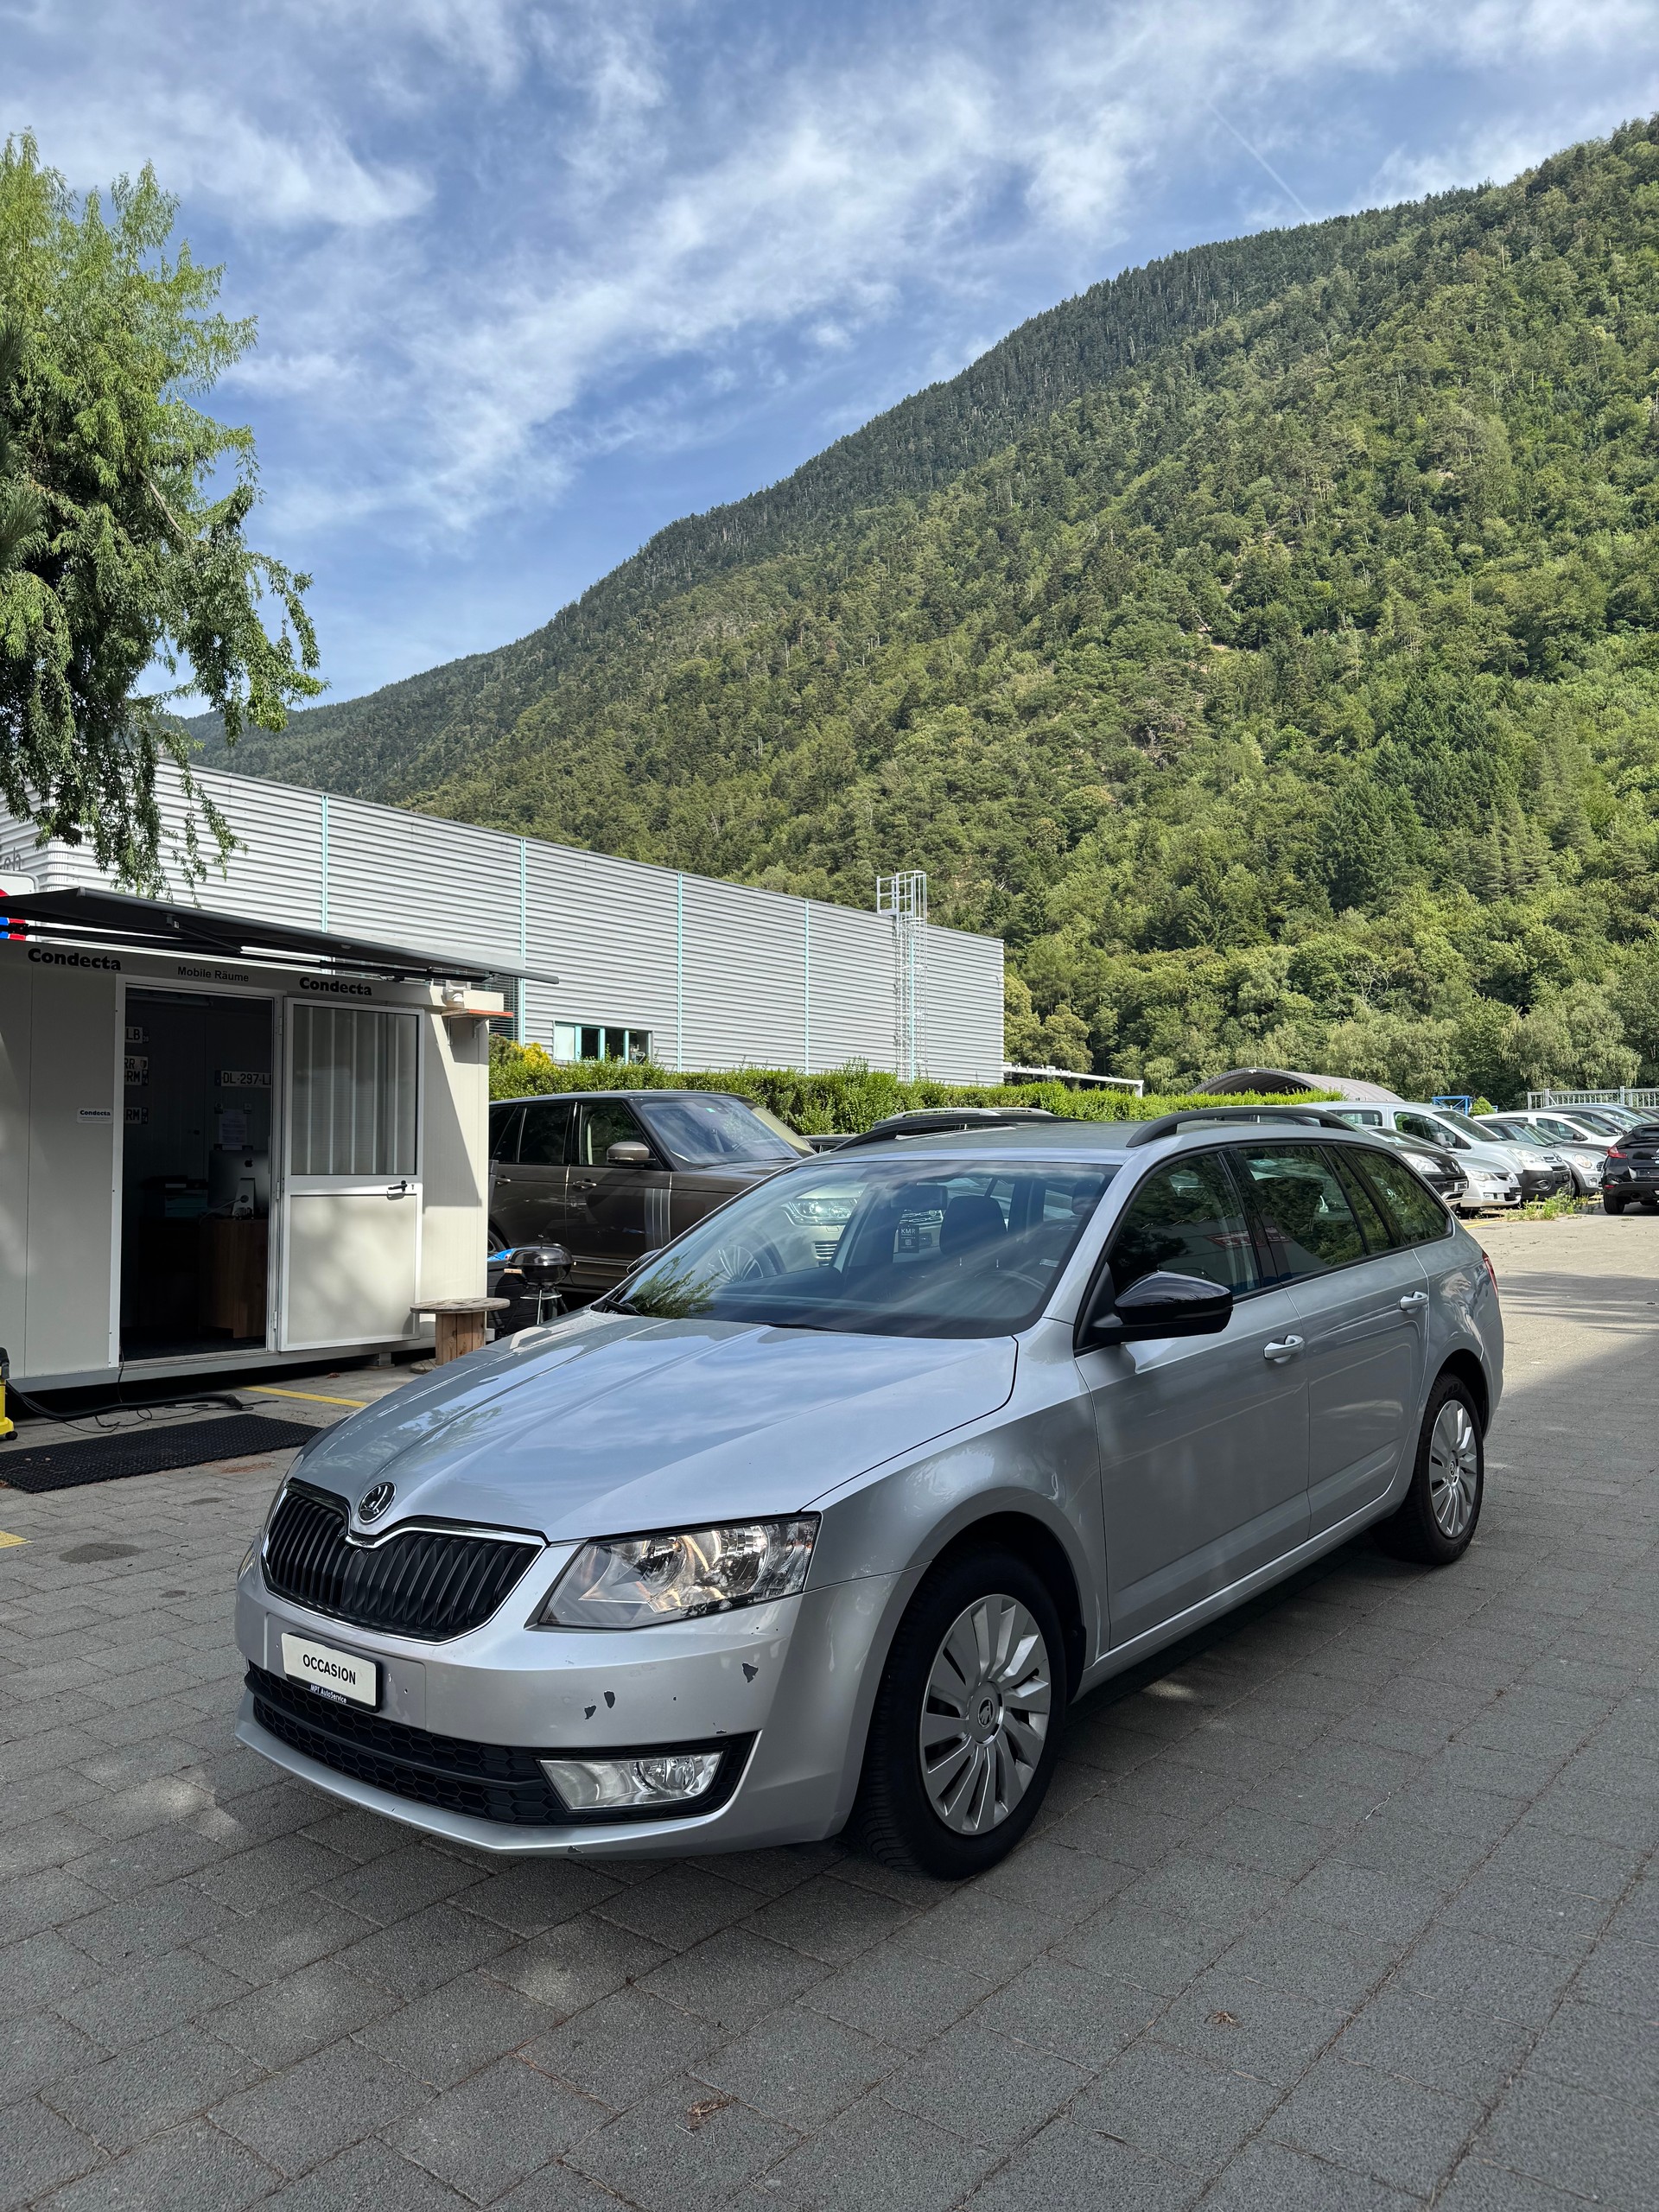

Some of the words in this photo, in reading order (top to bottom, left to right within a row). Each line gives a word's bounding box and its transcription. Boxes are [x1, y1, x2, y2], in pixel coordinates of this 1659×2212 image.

[28, 948, 121, 970] Condecta
[177, 966, 212, 978] Mobile
[214, 969, 249, 982] Räume
[299, 976, 372, 995] Condecta
[223, 1072, 271, 1085] DL-297-L
[302, 1654, 356, 1685] OCCASION
[321, 1688, 346, 1704] AutoService
